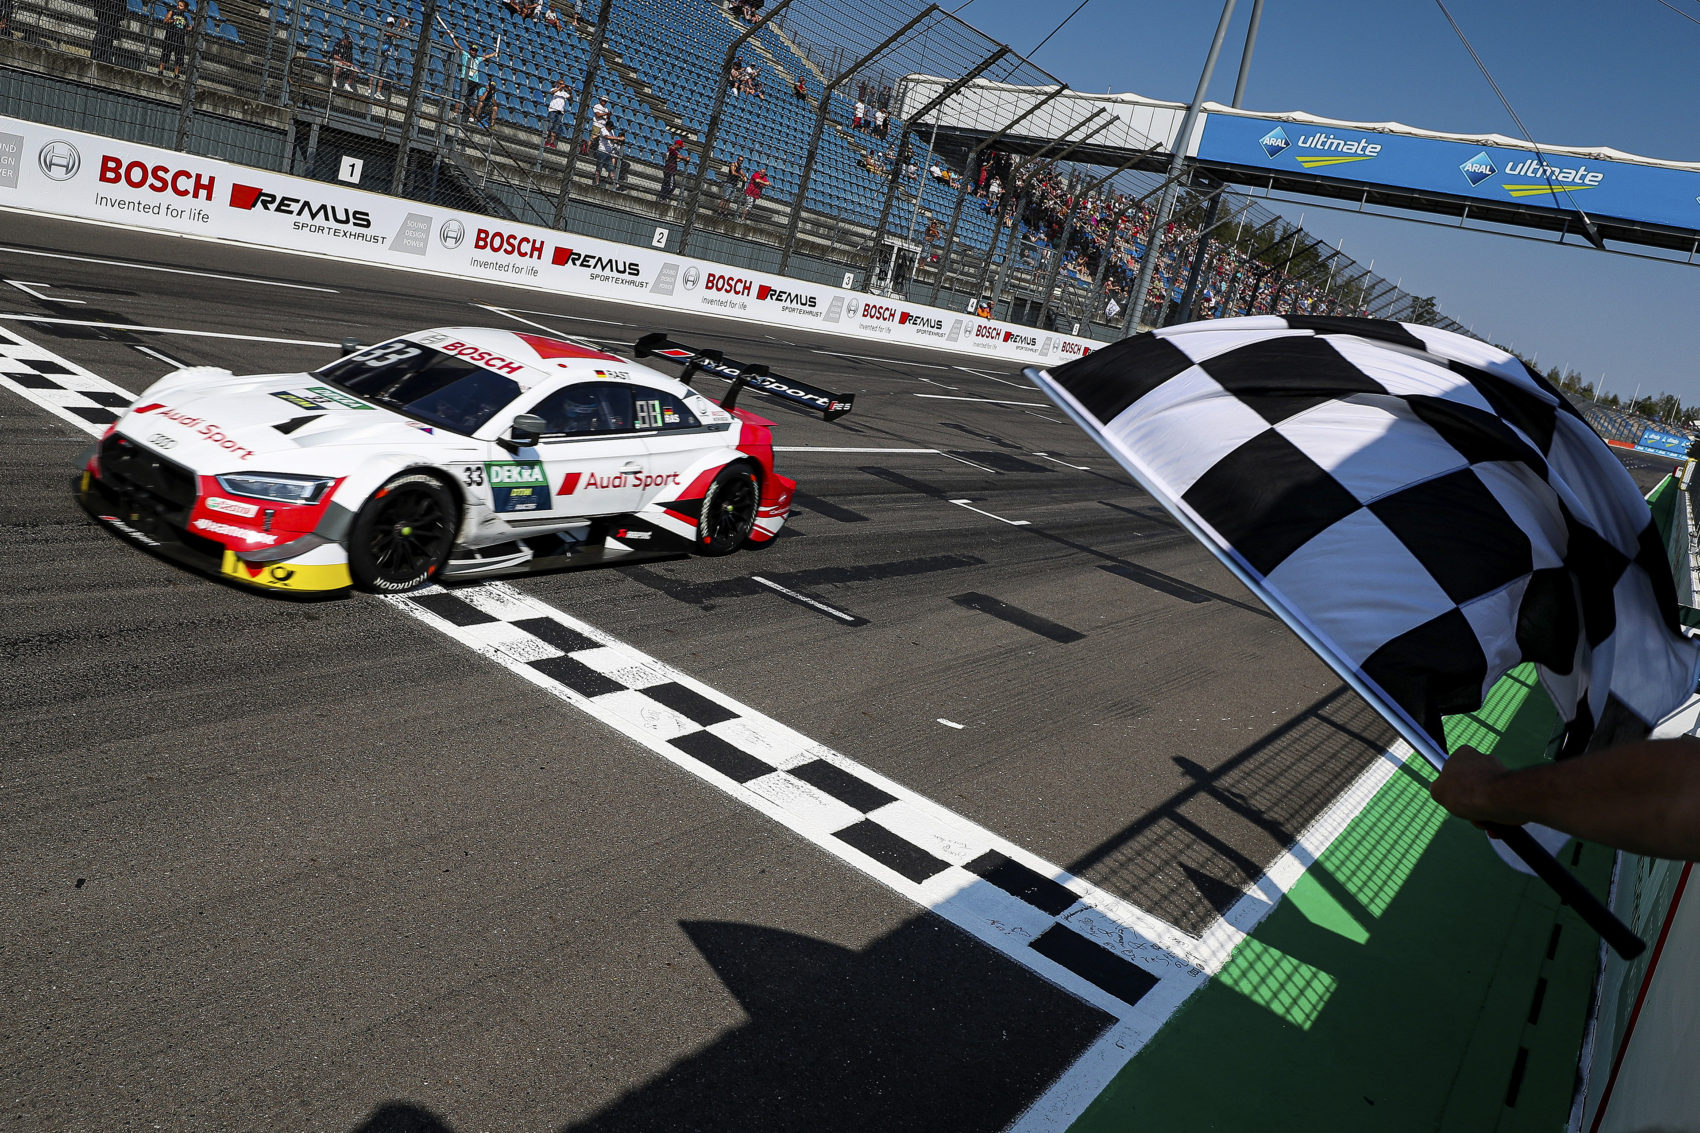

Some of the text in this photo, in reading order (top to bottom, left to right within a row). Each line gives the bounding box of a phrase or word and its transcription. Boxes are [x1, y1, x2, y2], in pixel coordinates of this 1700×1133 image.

[1263, 133, 1381, 156] ARAL ultimate
[99, 154, 216, 201] BOSCH
[349, 162, 356, 178] 1
[1464, 159, 1604, 186] ARAL ultimate
[95, 192, 210, 223] Invented for life
[252, 191, 372, 229] REMUS
[293, 221, 387, 245] SPORTEXHAUST
[405, 230, 426, 239] DESIGN
[406, 220, 428, 230] SOUND
[403, 239, 424, 249] POWER
[474, 228, 545, 260] BOSCH
[657, 232, 665, 244] 2
[470, 257, 539, 278] Invented for life
[565, 251, 640, 277] REMUS
[589, 273, 649, 289] SPORTEXHAUST
[705, 273, 752, 297] BOSCH
[845, 276, 850, 285] 3
[701, 295, 748, 311] Invented for life
[766, 288, 817, 308] REMUS
[781, 305, 822, 317] SPORTEXHAUST
[862, 303, 896, 322] BOSCH
[906, 314, 942, 330] REMUS
[975, 325, 1002, 340] BOSCH
[1007, 334, 1037, 346] REMUS
[352, 343, 423, 367] 33
[441, 341, 524, 375] BOSCH
[1061, 341, 1082, 355] BOSCH
[155, 408, 255, 460] Audi Sport
[463, 466, 484, 487] 33
[490, 465, 544, 483] DEKRA
[584, 471, 681, 492] Audi Sport
